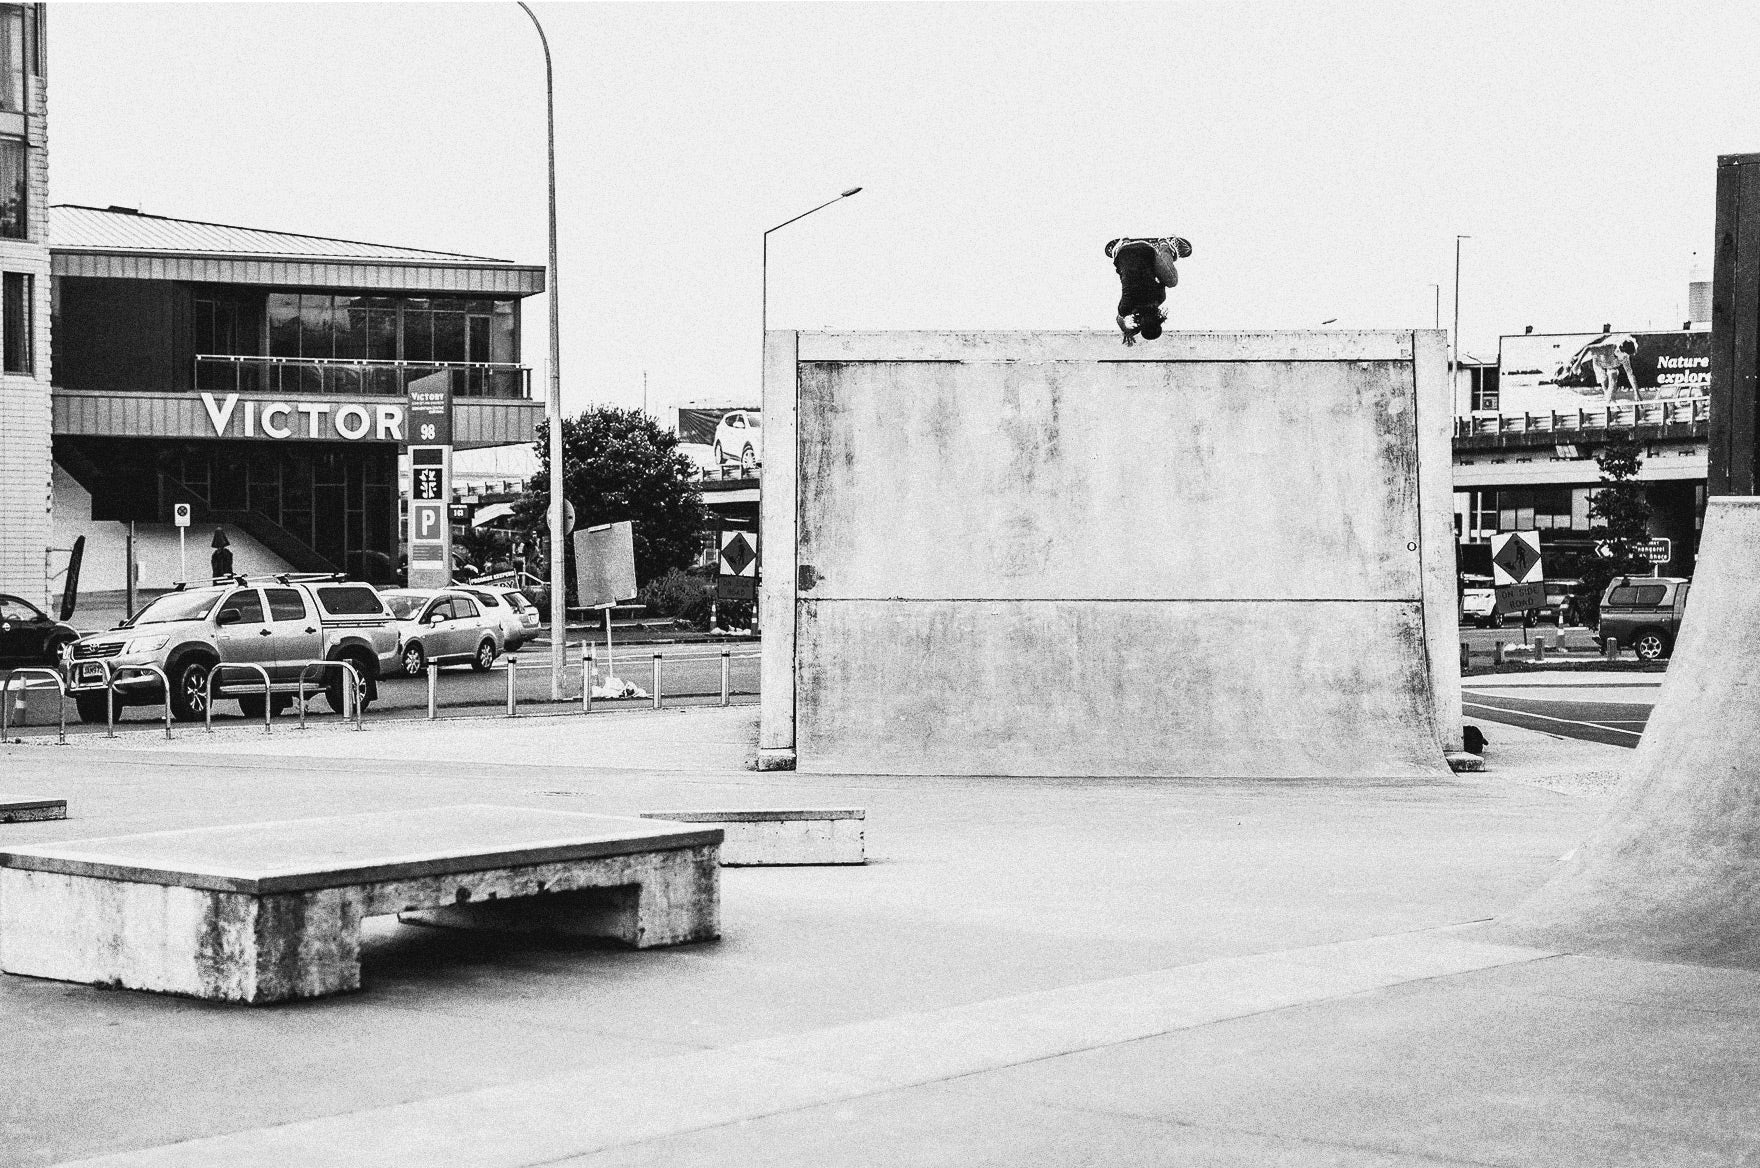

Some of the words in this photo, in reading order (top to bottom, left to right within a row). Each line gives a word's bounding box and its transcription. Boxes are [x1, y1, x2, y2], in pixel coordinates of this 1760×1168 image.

[1657, 355, 1710, 368] Nature
[420, 423, 436, 440] 98
[422, 509, 436, 536] P
